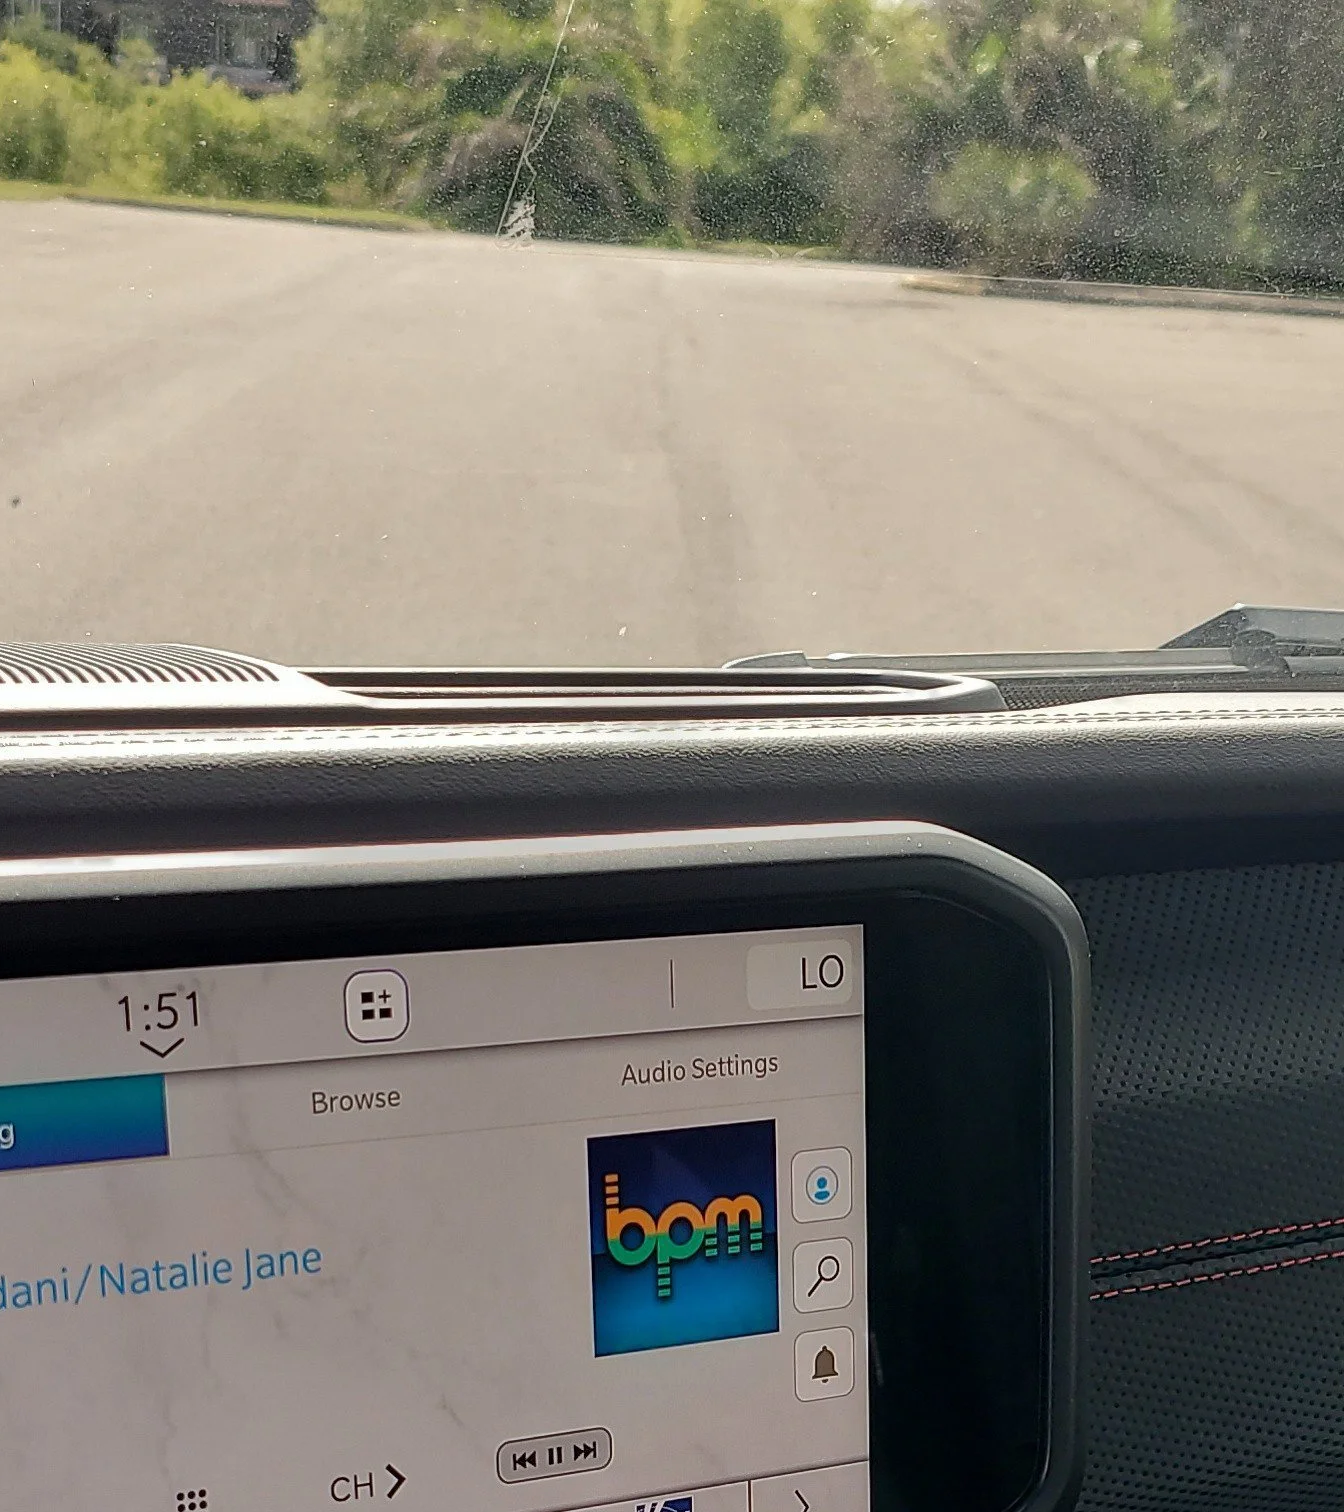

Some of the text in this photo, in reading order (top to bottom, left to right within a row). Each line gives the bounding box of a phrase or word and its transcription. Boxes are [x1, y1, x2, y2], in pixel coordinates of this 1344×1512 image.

[799, 955, 846, 992] LO
[117, 991, 203, 1033] 1:51
[620, 1052, 780, 1087] Audio Settings
[311, 1085, 402, 1115] Browse
[604, 1172, 764, 1300] bpm
[242, 1245, 324, 1291] Jane
[330, 1472, 374, 1502] CH
